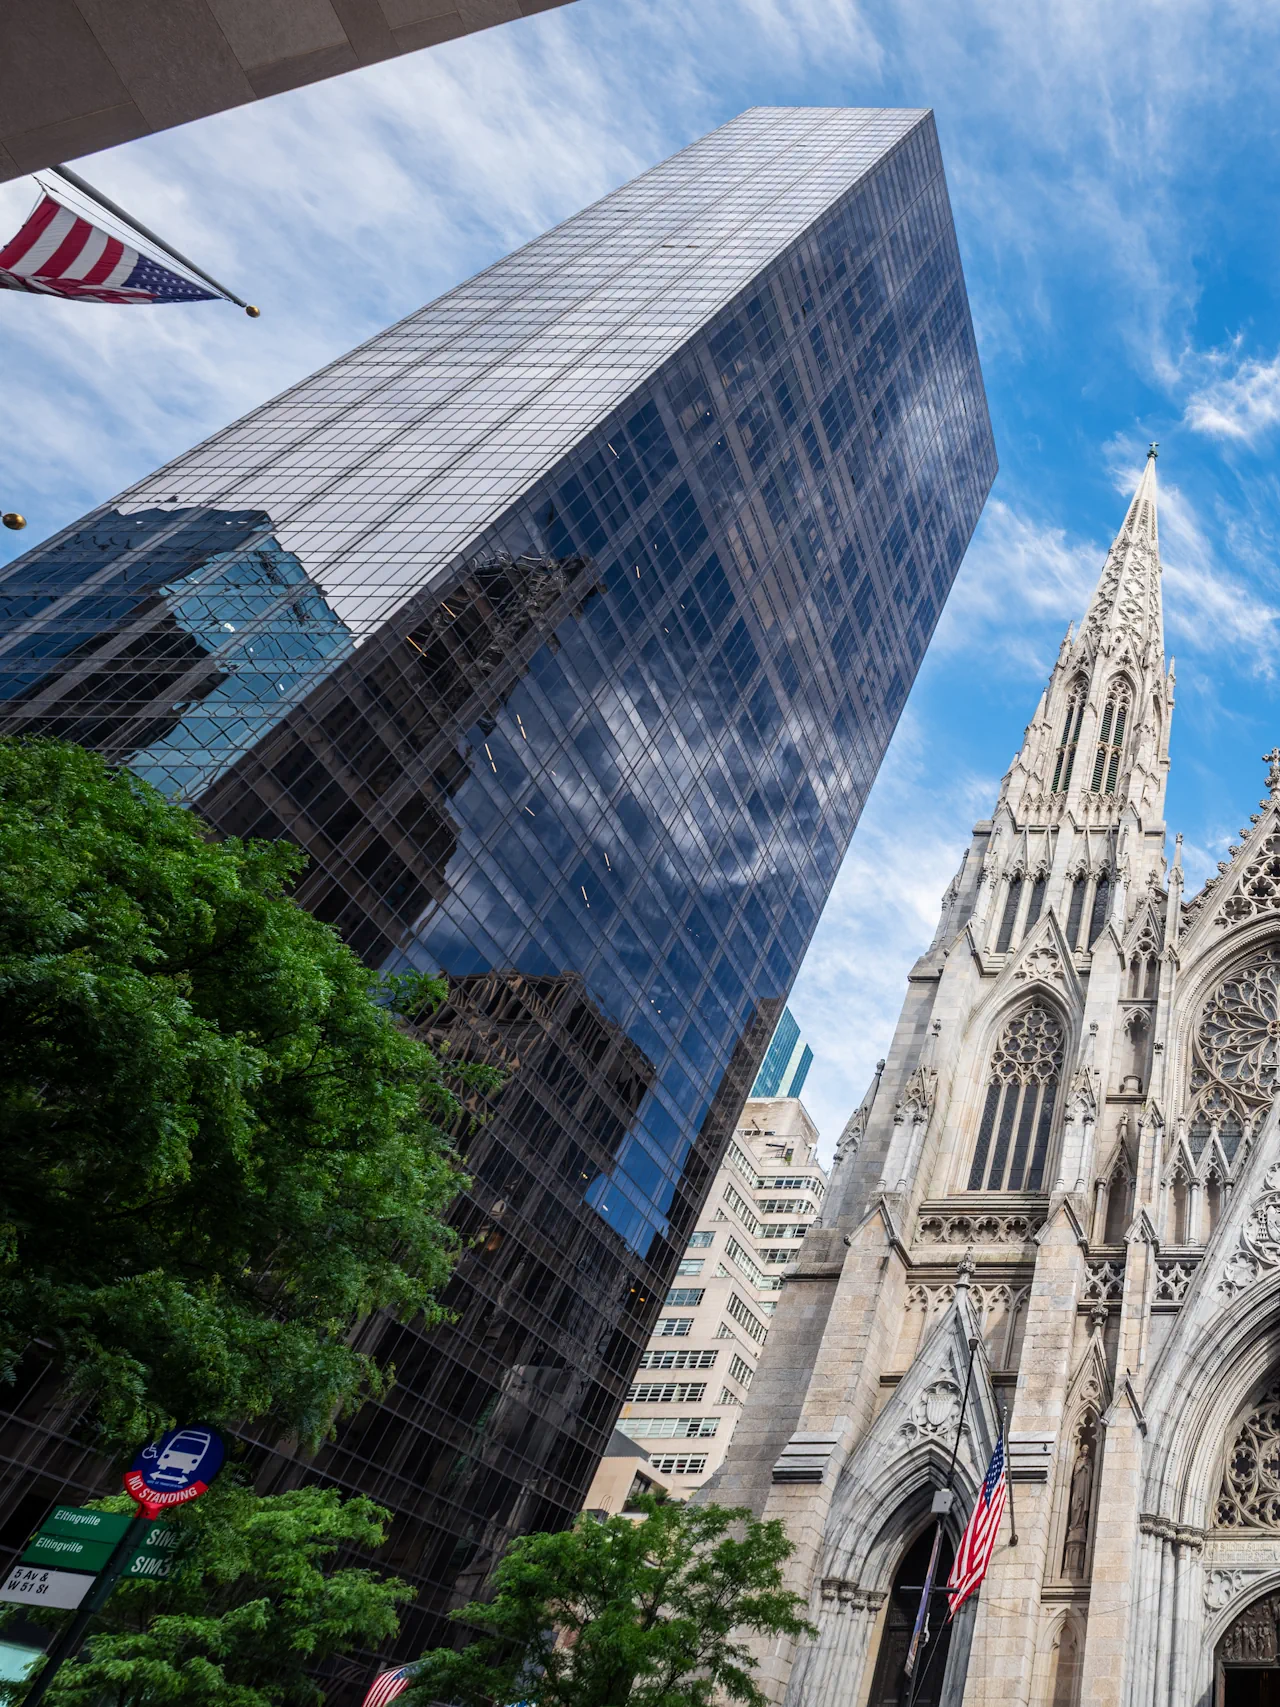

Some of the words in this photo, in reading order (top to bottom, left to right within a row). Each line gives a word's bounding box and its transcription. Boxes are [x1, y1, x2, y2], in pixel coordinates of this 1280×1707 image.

[128, 1475, 143, 1491] NO
[139, 1487, 198, 1503] STANDING
[54, 1510, 101, 1526] Eltingville
[35, 1537, 83, 1553] Eltingville
[146, 1528, 177, 1548] SIM
[14, 1569, 24, 1578] 5
[23, 1570, 38, 1581] Av
[40, 1572, 49, 1582] &
[7, 1580, 21, 1591] W
[20, 1582, 35, 1592] 51
[36, 1584, 49, 1594] St
